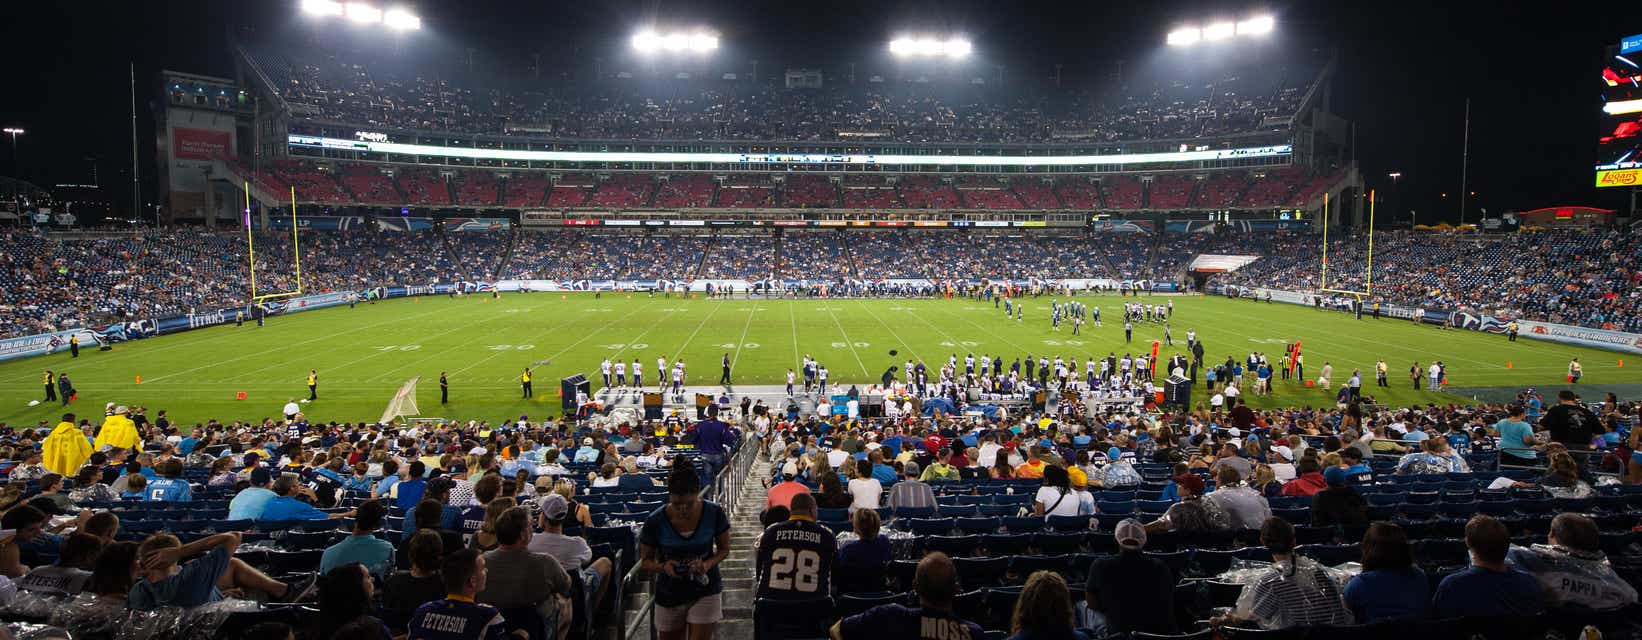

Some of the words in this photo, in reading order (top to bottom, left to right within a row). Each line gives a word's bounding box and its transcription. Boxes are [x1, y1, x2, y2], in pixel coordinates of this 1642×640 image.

[776, 530, 822, 544] PETERSON
[769, 548, 820, 592] 28
[422, 611, 469, 634] PETERSON
[920, 616, 974, 640] MOSS
